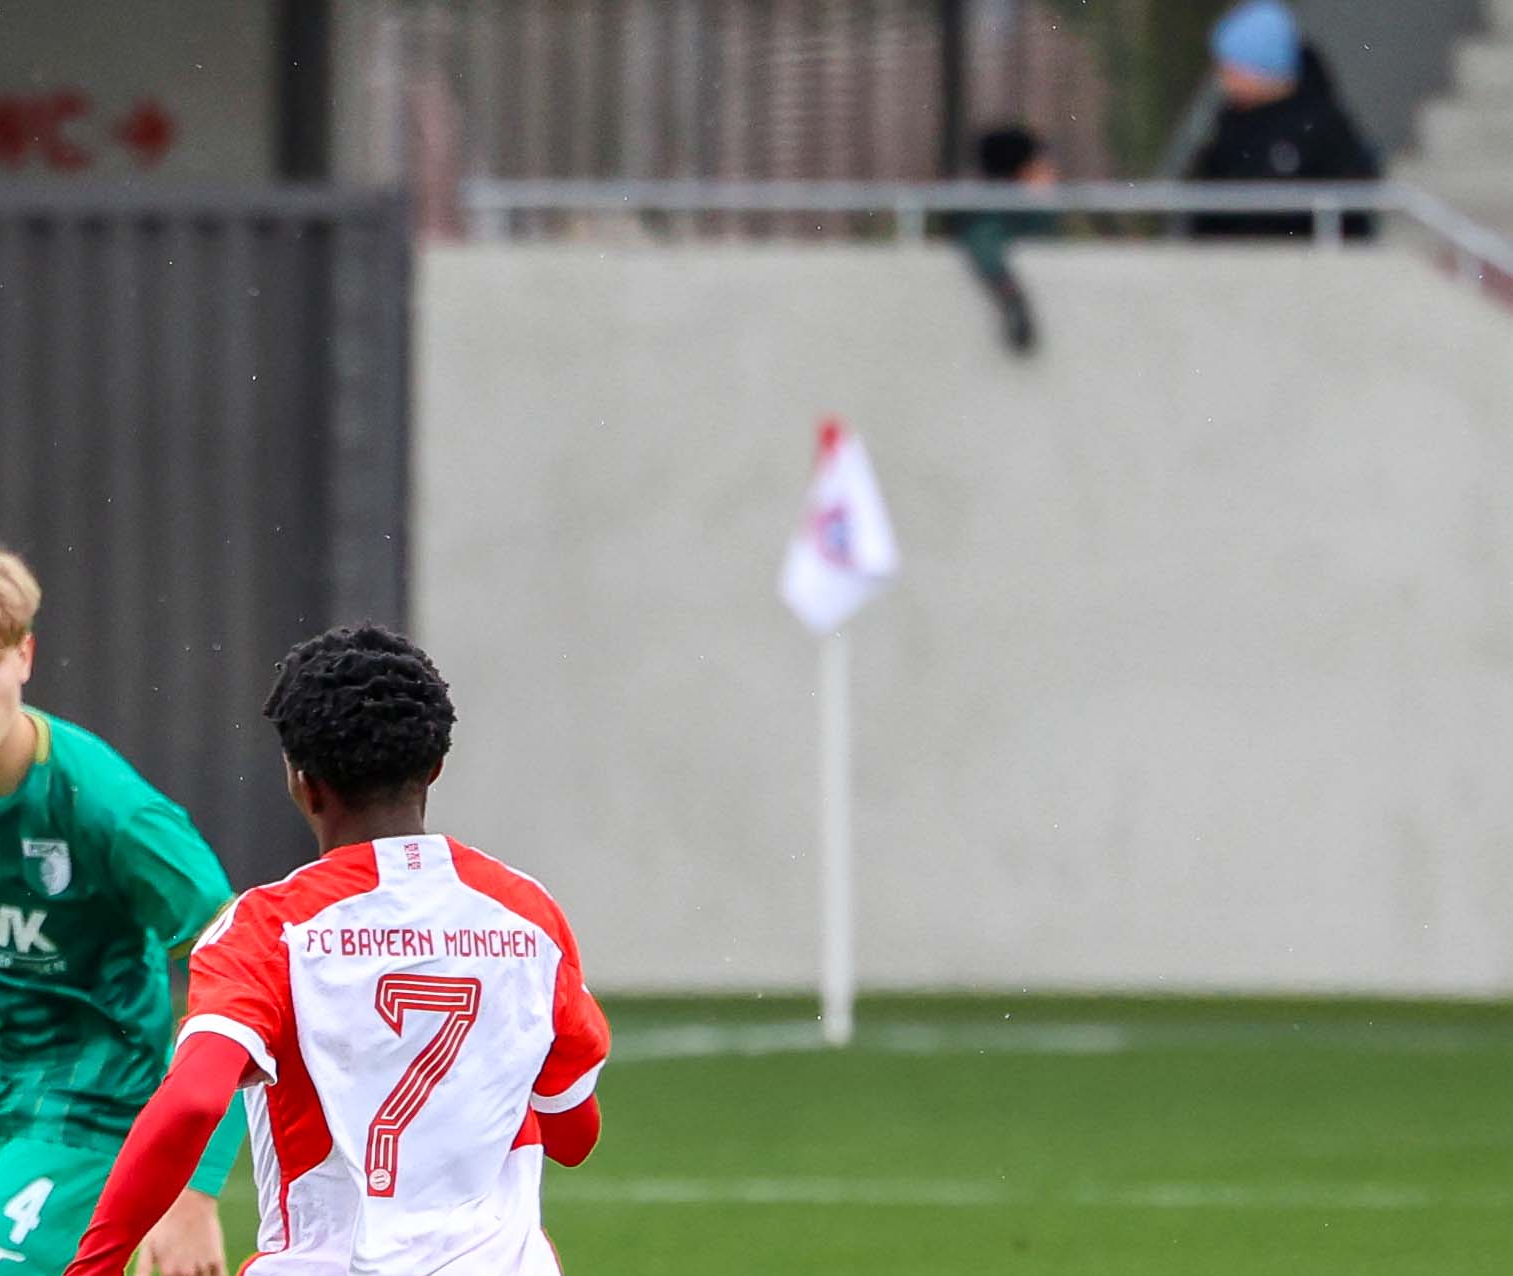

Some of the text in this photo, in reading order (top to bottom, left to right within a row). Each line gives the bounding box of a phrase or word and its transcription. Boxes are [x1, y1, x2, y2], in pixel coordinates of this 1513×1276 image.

[306, 928, 538, 958] FC BAYERN MÜNCHEN
[365, 973, 482, 1198] 7
[3, 1176, 54, 1245] 4
